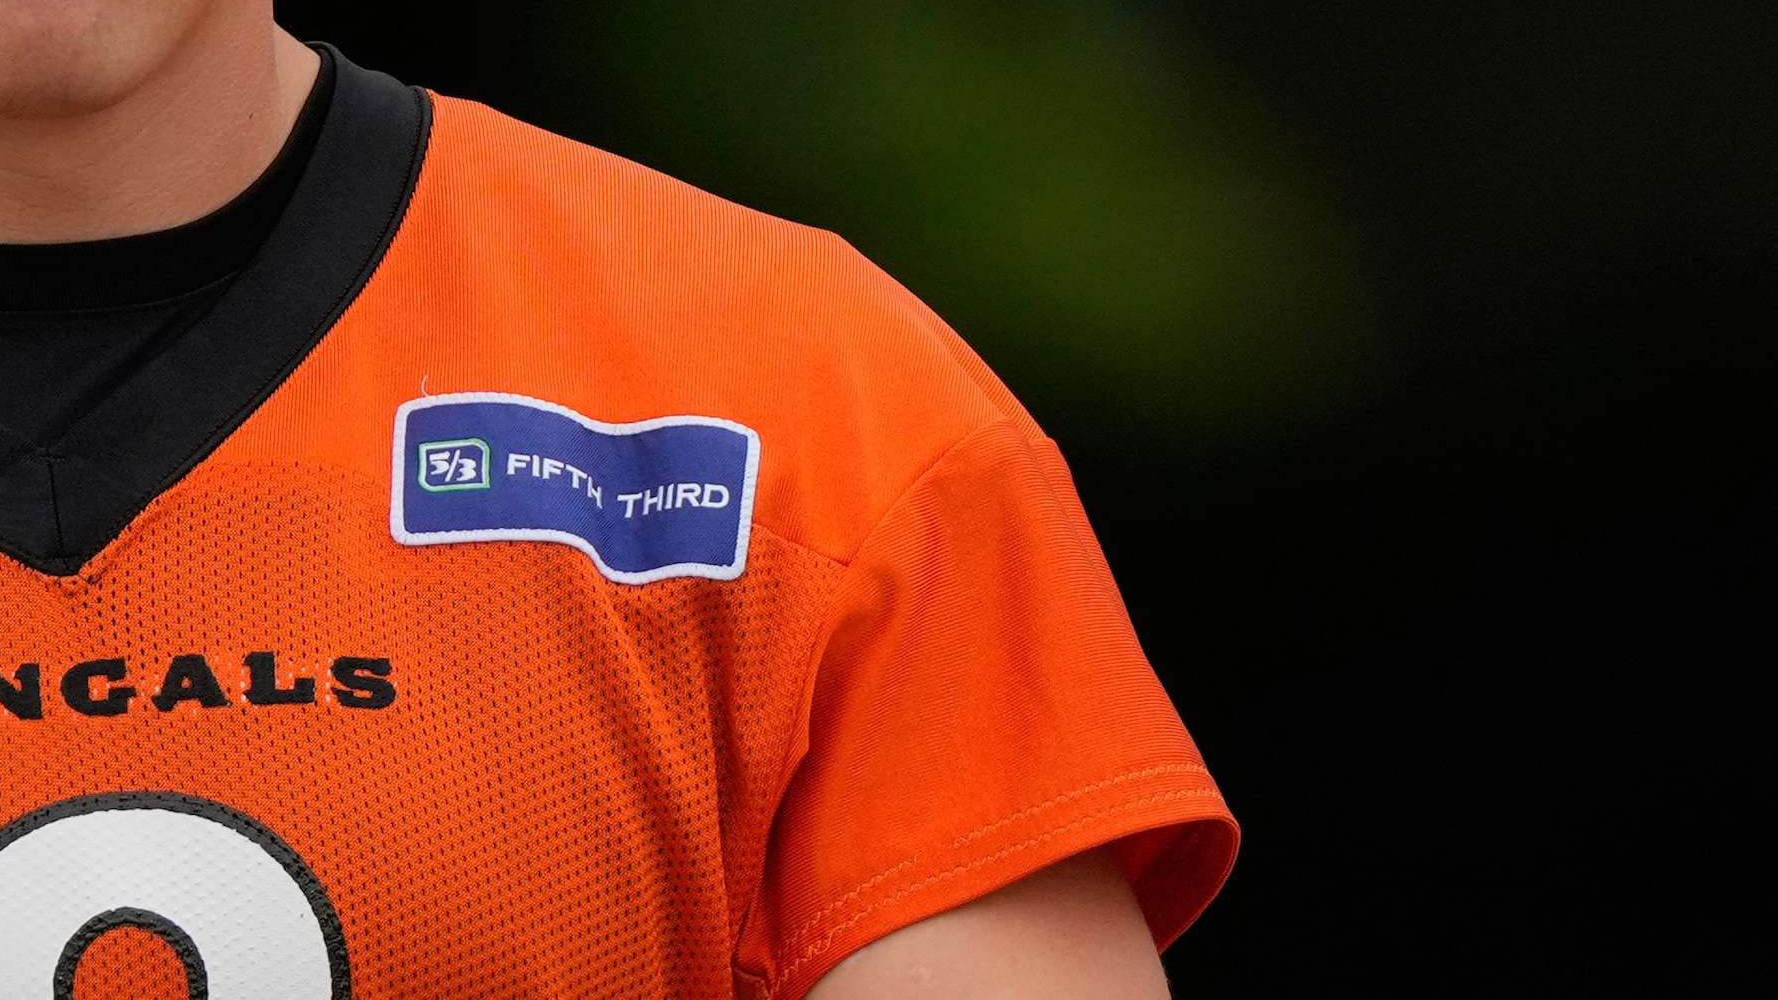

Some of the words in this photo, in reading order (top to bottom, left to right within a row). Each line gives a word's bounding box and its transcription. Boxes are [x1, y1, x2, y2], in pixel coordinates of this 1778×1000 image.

[428, 448, 478, 483] 5/3
[506, 452, 604, 509] FIFTH
[616, 482, 731, 519] THIRD
